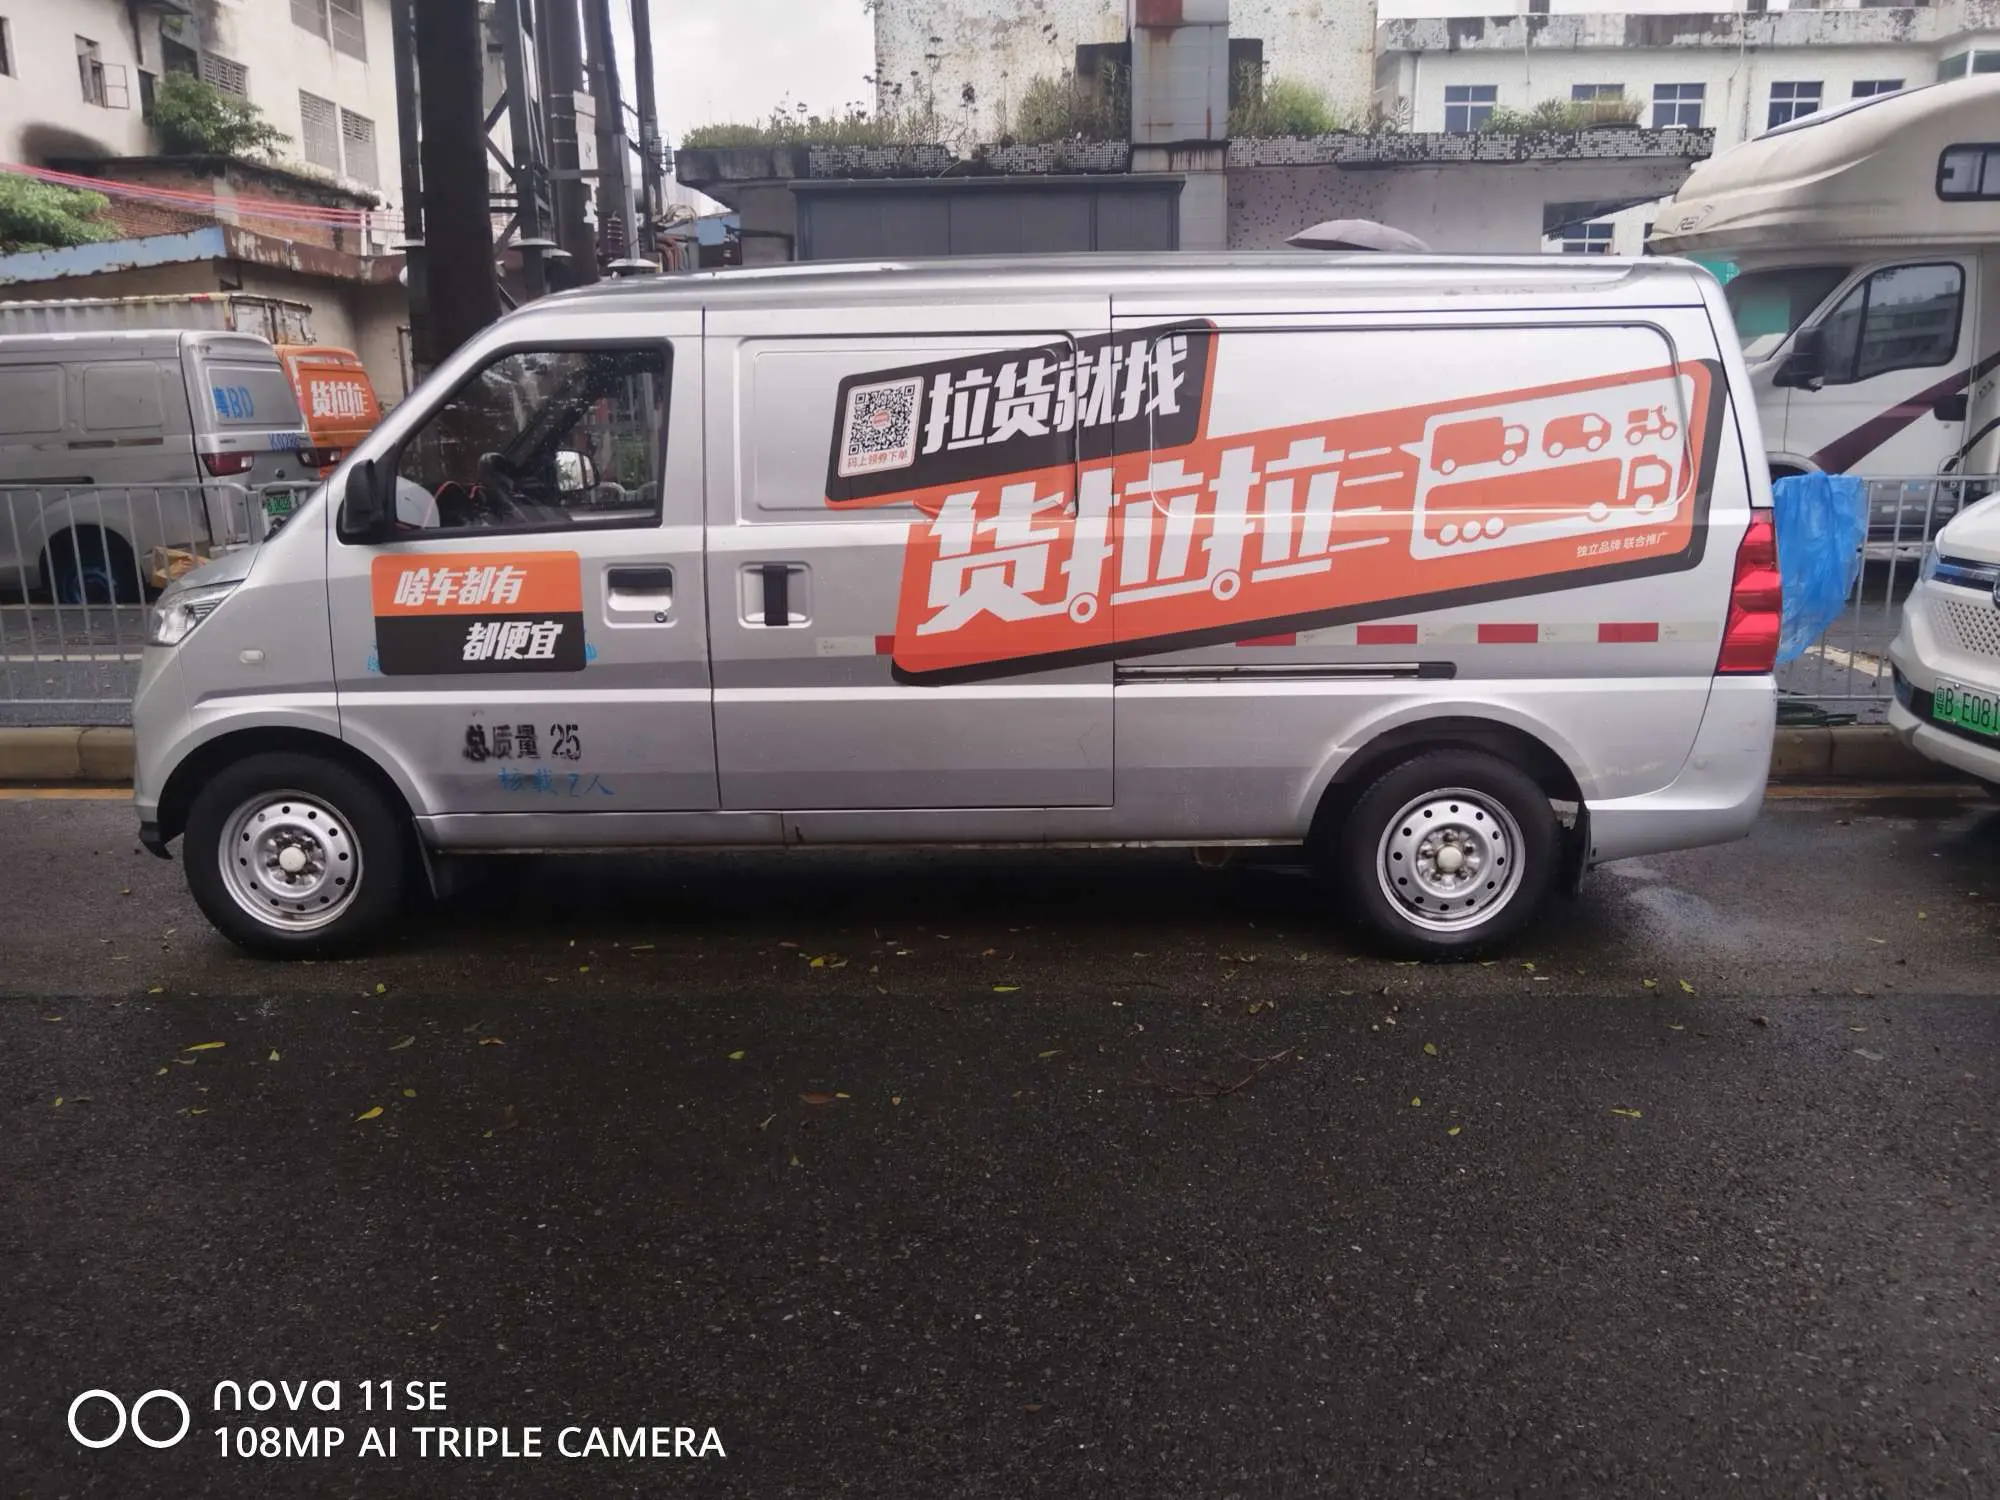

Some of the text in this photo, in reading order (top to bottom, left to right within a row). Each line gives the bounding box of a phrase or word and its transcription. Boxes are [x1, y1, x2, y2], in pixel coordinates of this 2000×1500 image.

[310, 380, 368, 420] 货拉拉
[922, 335, 1187, 455] 拉货就找
[916, 436, 1345, 636] 货拉拉
[393, 565, 527, 606] 啥车都有
[462, 620, 564, 661] 都便宜
